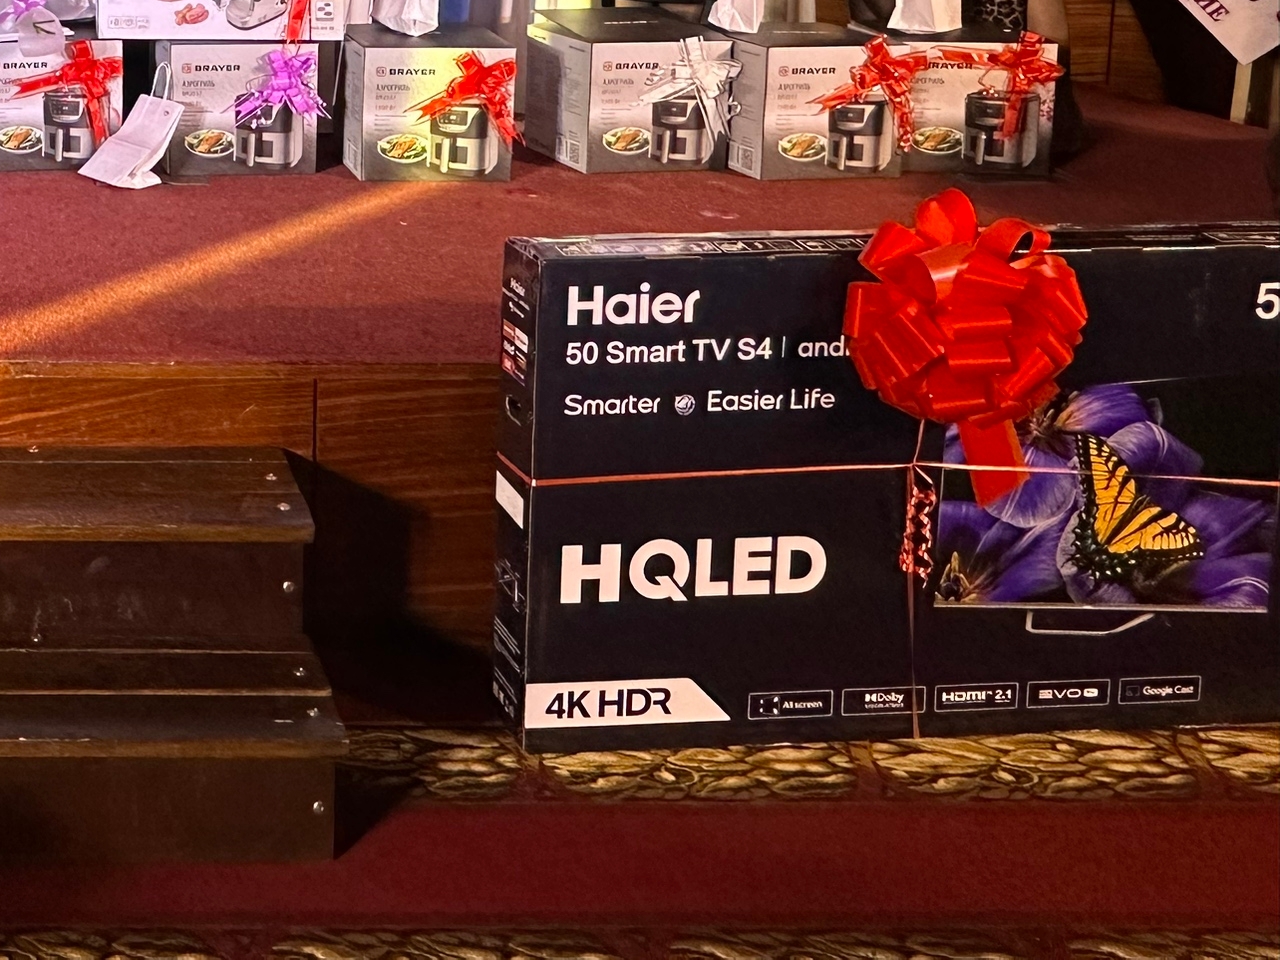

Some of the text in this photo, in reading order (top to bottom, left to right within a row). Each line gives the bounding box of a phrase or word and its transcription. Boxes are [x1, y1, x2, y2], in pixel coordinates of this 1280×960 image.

[3, 61, 48, 70] BRAYER
[194, 64, 241, 72] BRAYER
[388, 68, 436, 76] BRAYER
[791, 67, 837, 75] BRAYER
[566, 282, 701, 326] Haier
[566, 335, 850, 365] 50 Smart TV S4 and
[563, 388, 836, 417] Smarter Easier Life
[559, 535, 828, 604] HQLED
[545, 689, 592, 720] 4K
[598, 687, 672, 718] HDR
[994, 688, 1012, 700] 2.1
